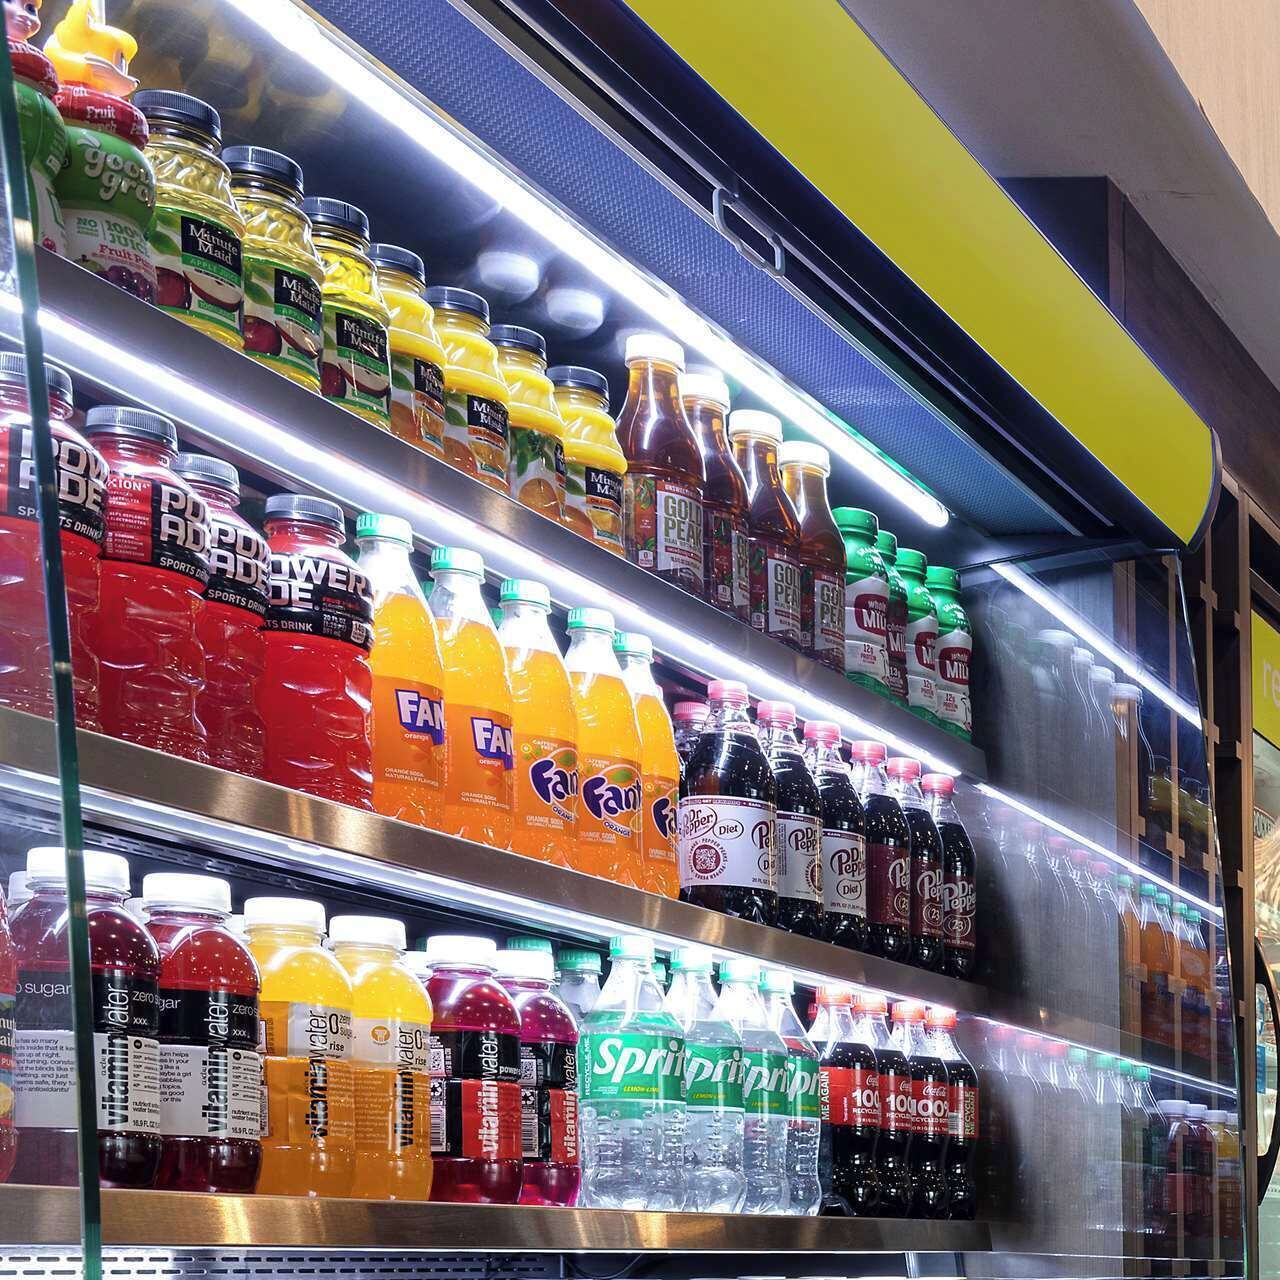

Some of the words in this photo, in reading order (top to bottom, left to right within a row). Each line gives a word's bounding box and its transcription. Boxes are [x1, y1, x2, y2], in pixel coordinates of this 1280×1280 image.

[86, 105, 116, 120] Fruit
[77, 217, 98, 228] NO
[188, 224, 238, 256] Minute
[198, 239, 233, 265] Maid
[282, 276, 320, 305] Minute
[290, 290, 317, 314] Maid
[343, 319, 385, 346] Minute
[351, 335, 379, 352] Maid
[160, 557, 195, 575] SPORTS
[270, 554, 367, 593] OWER
[207, 589, 247, 606] SPORTS
[247, 600, 266, 614] DRINK
[270, 580, 314, 610] DE
[281, 621, 313, 633] DRINK
[690, 809, 701, 821] Dr
[683, 813, 713, 836] Pepper
[719, 825, 738, 835] Diet
[843, 885, 858, 895] Diet
[958, 881, 973, 896] Dr
[952, 919, 963, 930] 23
[25, 983, 72, 997] sugar
[133, 991, 154, 1003] zero
[232, 1004, 253, 1016] zero
[329, 1041, 344, 1051] rise
[415, 1056, 426, 1065] rise
[821, 1072, 829, 1106] AGAIN
[821, 1107, 829, 1120] ME
